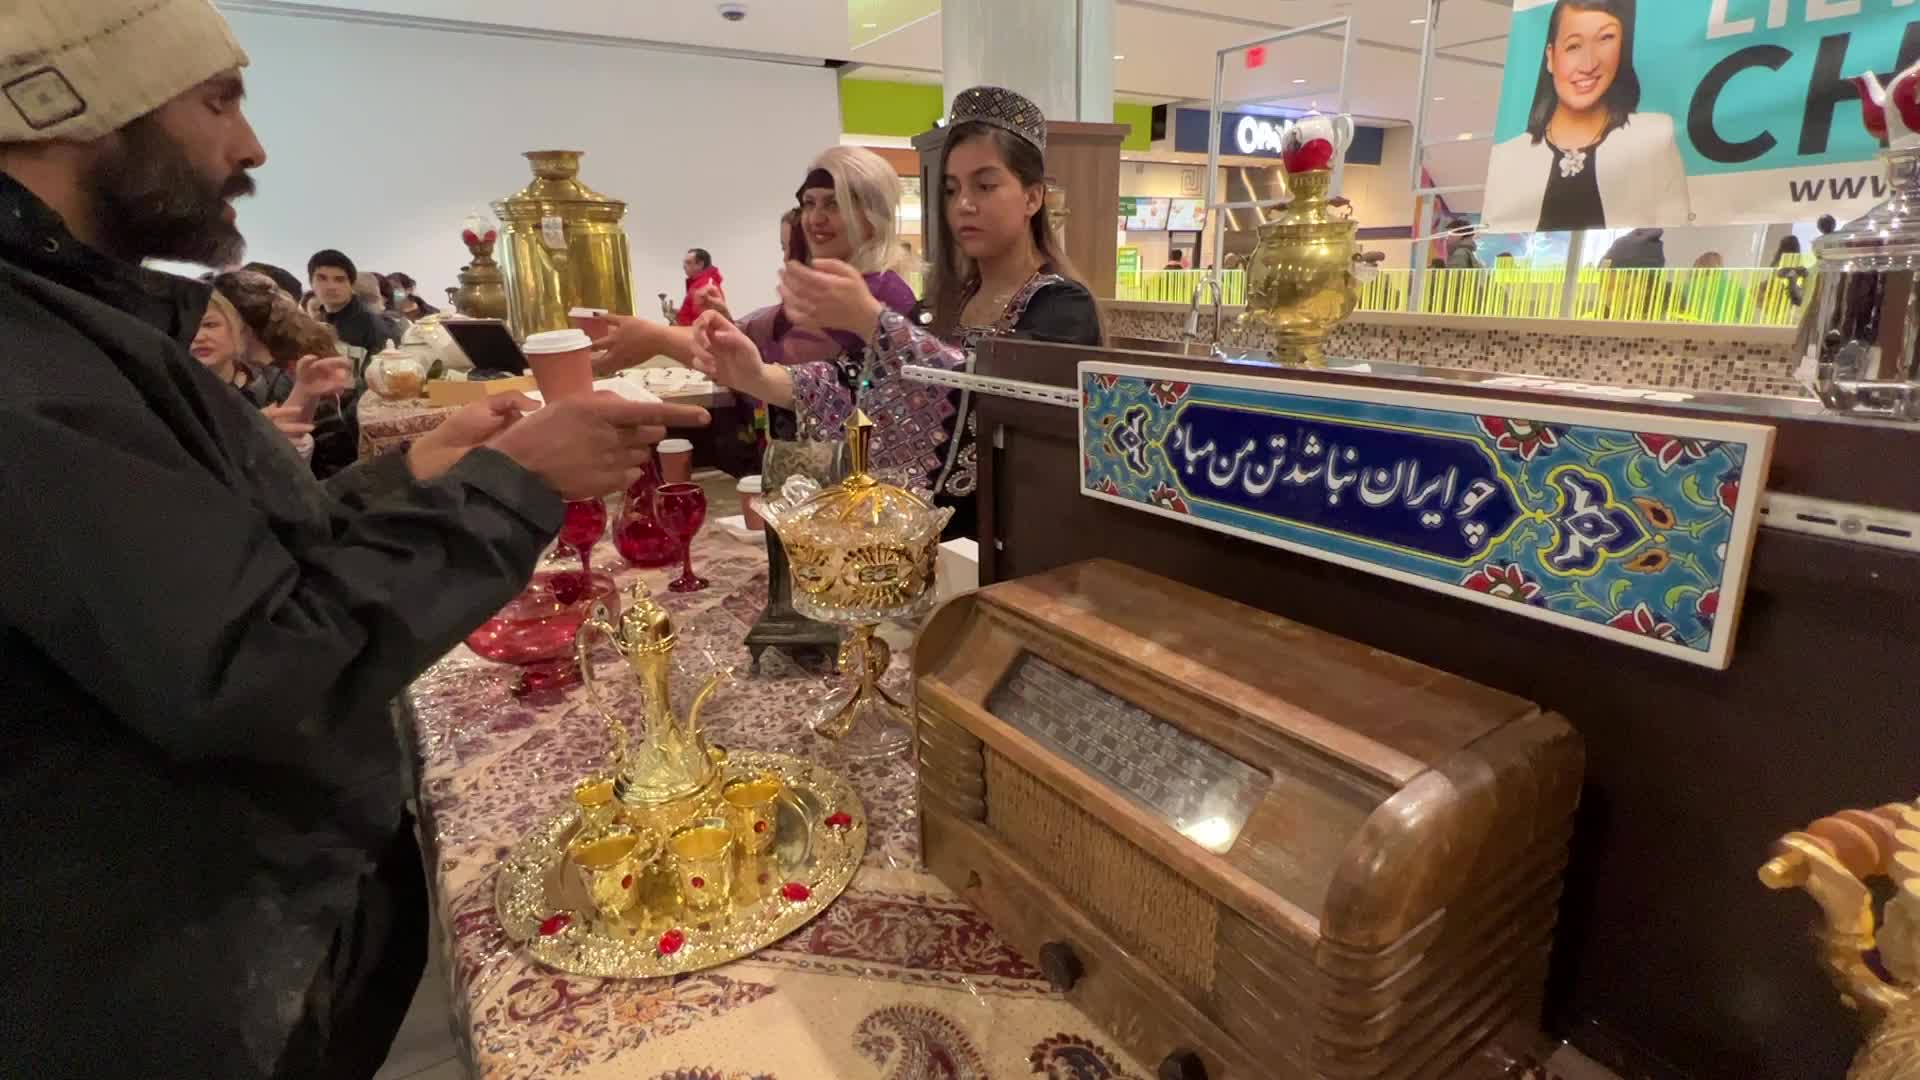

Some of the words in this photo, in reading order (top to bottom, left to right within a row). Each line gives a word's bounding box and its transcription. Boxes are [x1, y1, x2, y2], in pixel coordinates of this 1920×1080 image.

[1173, 422, 1215, 475] مباد
[1209, 439, 1255, 487] من
[1244, 437, 1286, 494] تن
[1282, 435, 1356, 505] نباشد
[1361, 462, 1457, 525] ایران
[1456, 482, 1496, 546] چو
